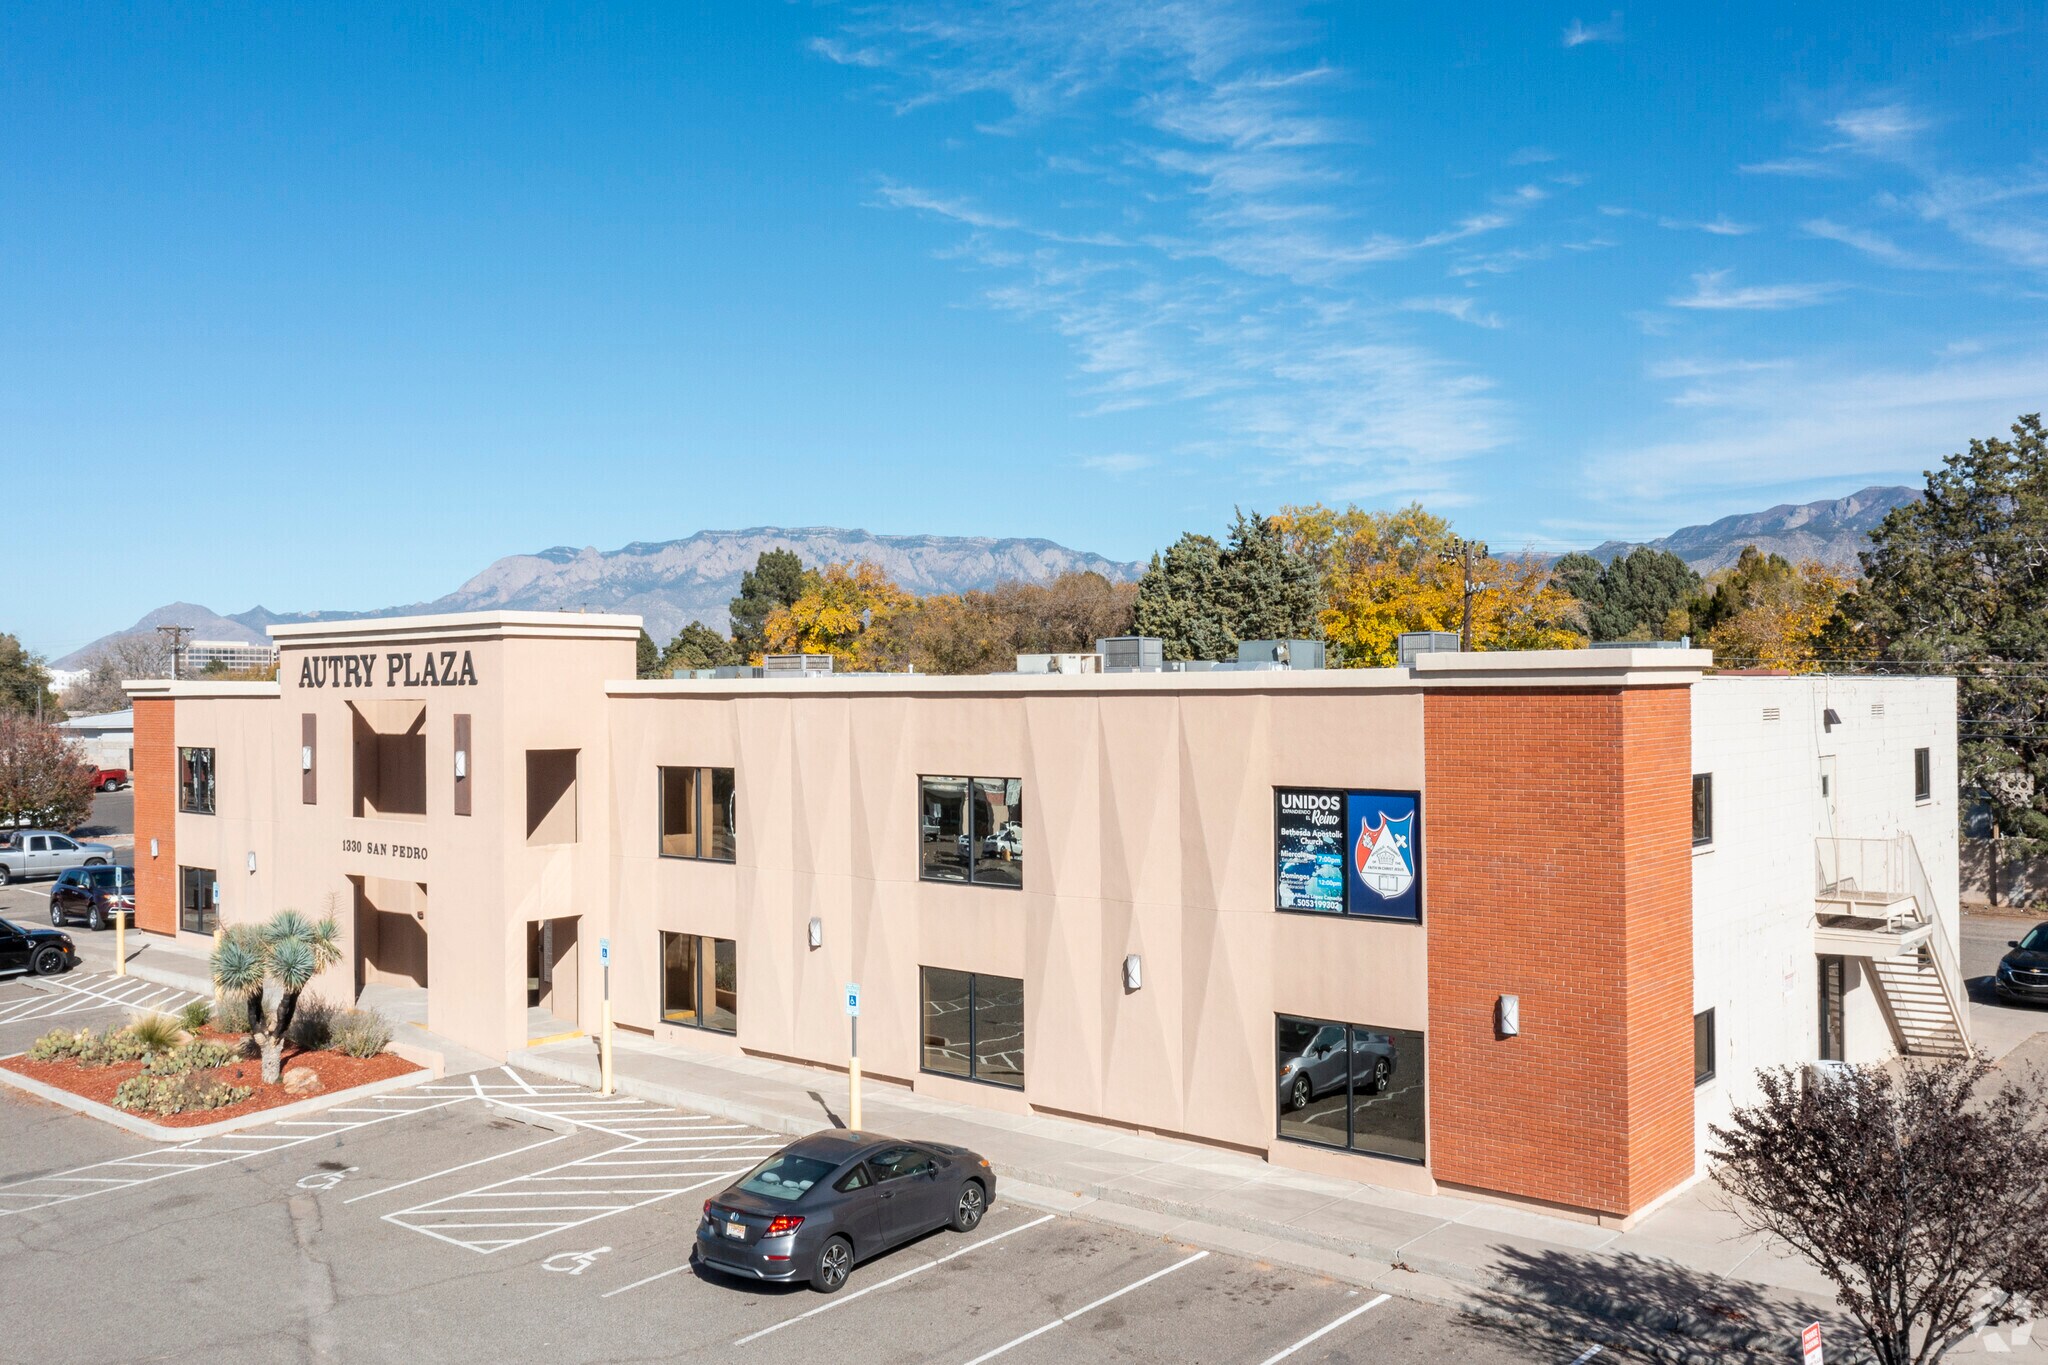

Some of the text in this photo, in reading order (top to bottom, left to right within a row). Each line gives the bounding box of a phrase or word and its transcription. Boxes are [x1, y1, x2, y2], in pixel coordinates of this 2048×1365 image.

[299, 650, 478, 688] AUTRY PLAZA
[1281, 794, 1340, 810] UNIDOS
[1311, 810, 1340, 826] Reino
[1281, 828, 1343, 839] Bethesda Apostolic
[1300, 837, 1323, 845] Church
[342, 839, 428, 860] 1330 SAN PEDRO
[1318, 856, 1341, 864] 7:00pm
[1280, 871, 1310, 881] Domingos
[1318, 879, 1342, 887] 12:00pm
[1297, 899, 1339, 909] 5053199302
